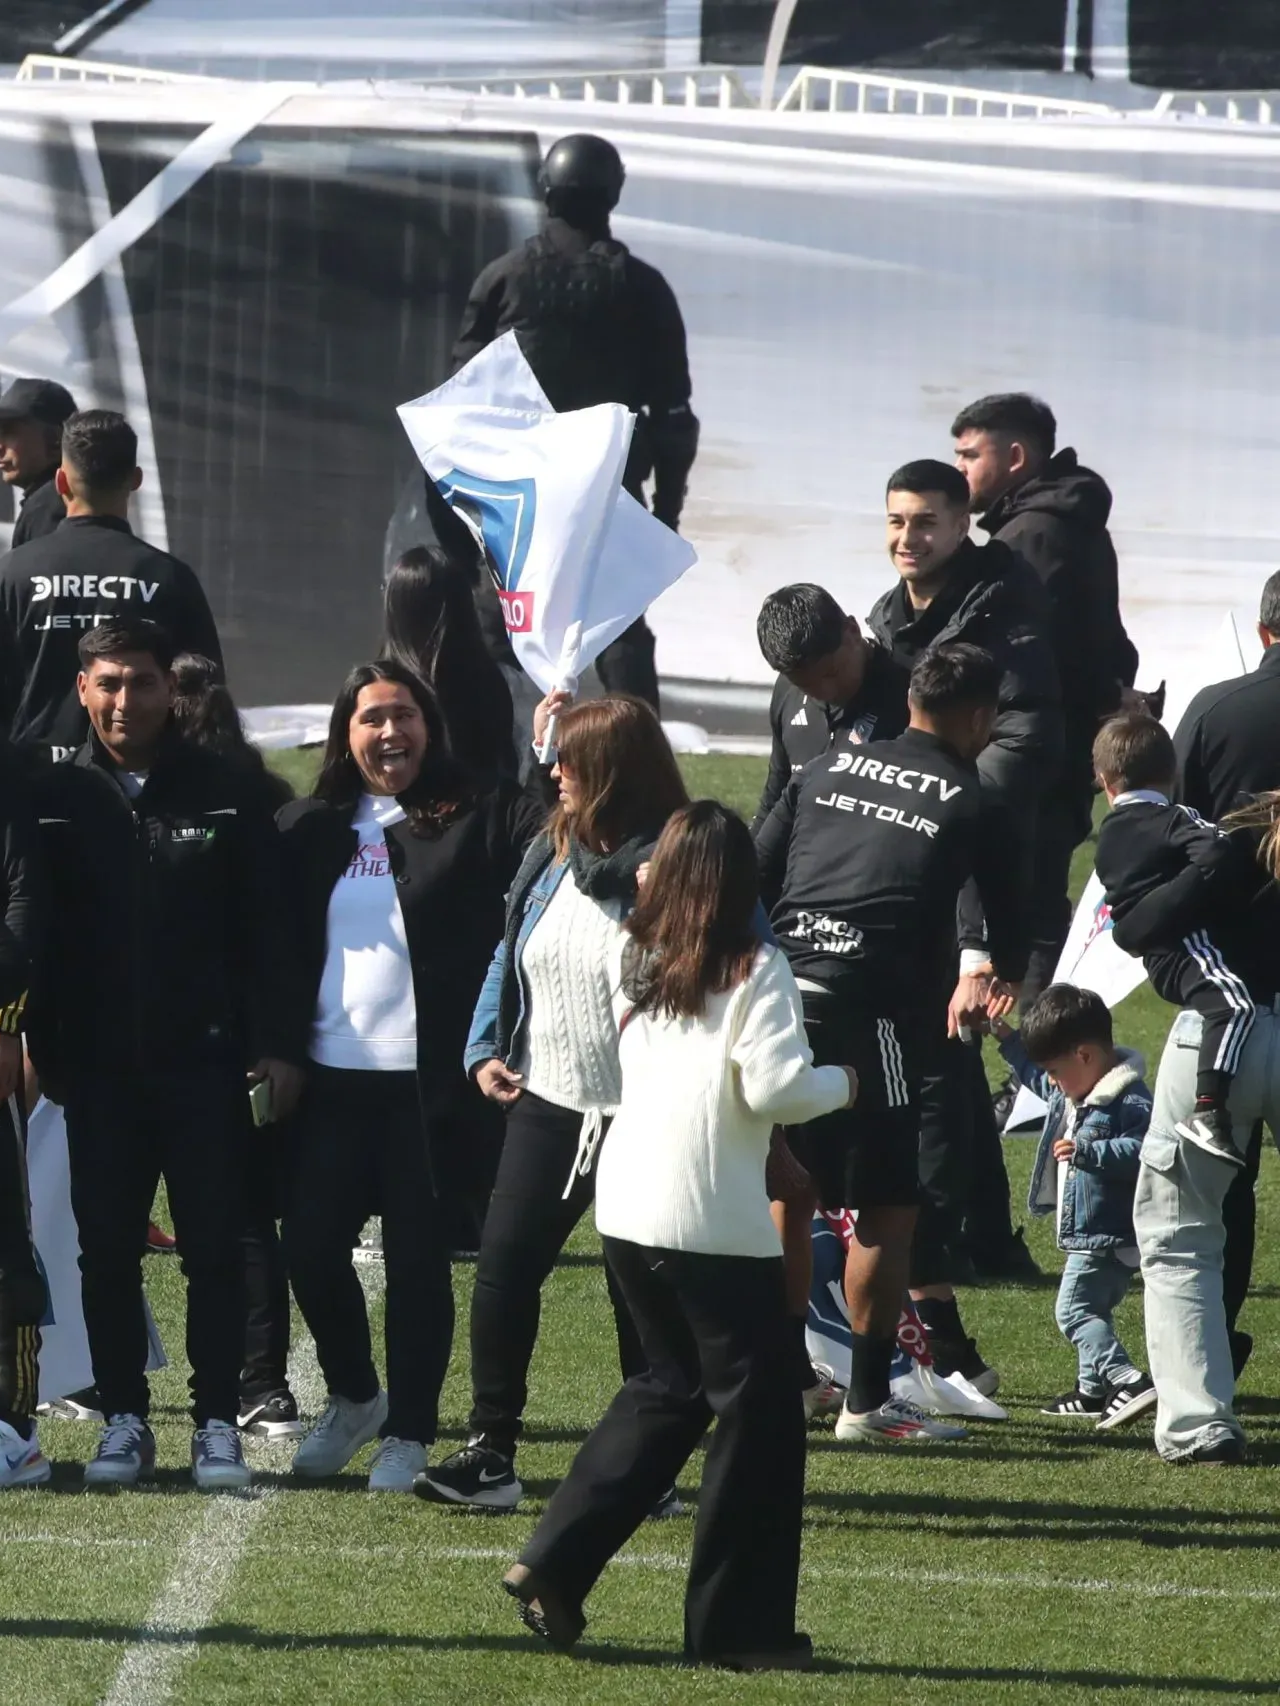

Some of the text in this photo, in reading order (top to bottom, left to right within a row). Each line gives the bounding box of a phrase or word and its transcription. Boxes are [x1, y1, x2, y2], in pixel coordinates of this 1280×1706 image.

[30, 574, 160, 603] DIRECTV
[828, 752, 963, 802] DIRECTV
[815, 792, 940, 839] JETOUR
